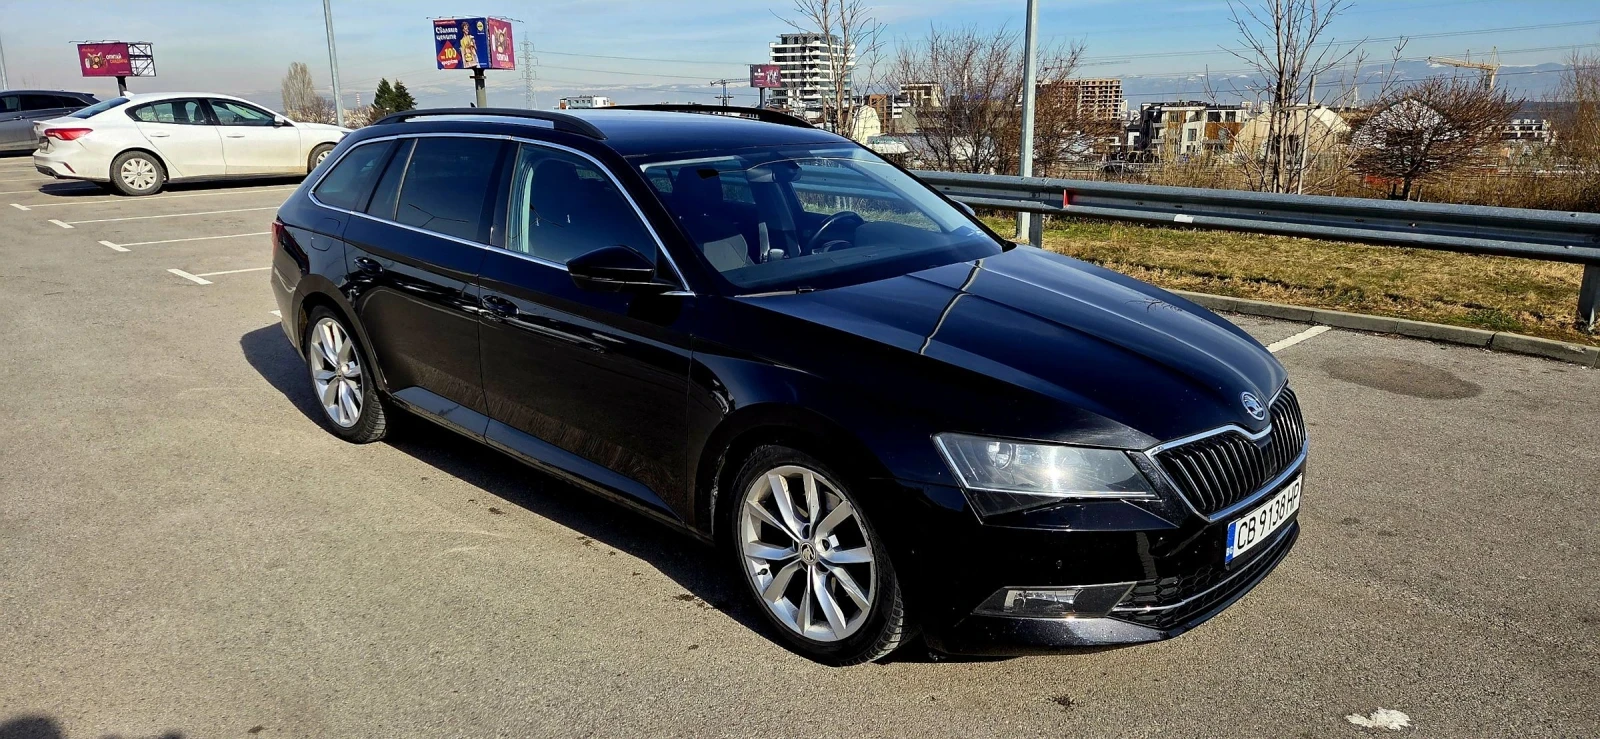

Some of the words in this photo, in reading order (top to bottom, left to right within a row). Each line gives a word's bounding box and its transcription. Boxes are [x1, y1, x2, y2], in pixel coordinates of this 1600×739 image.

[445, 48, 456, 58] 100
[1237, 516, 1256, 550] CB
[1259, 494, 1286, 537] 9138
[1286, 481, 1300, 515] HP
